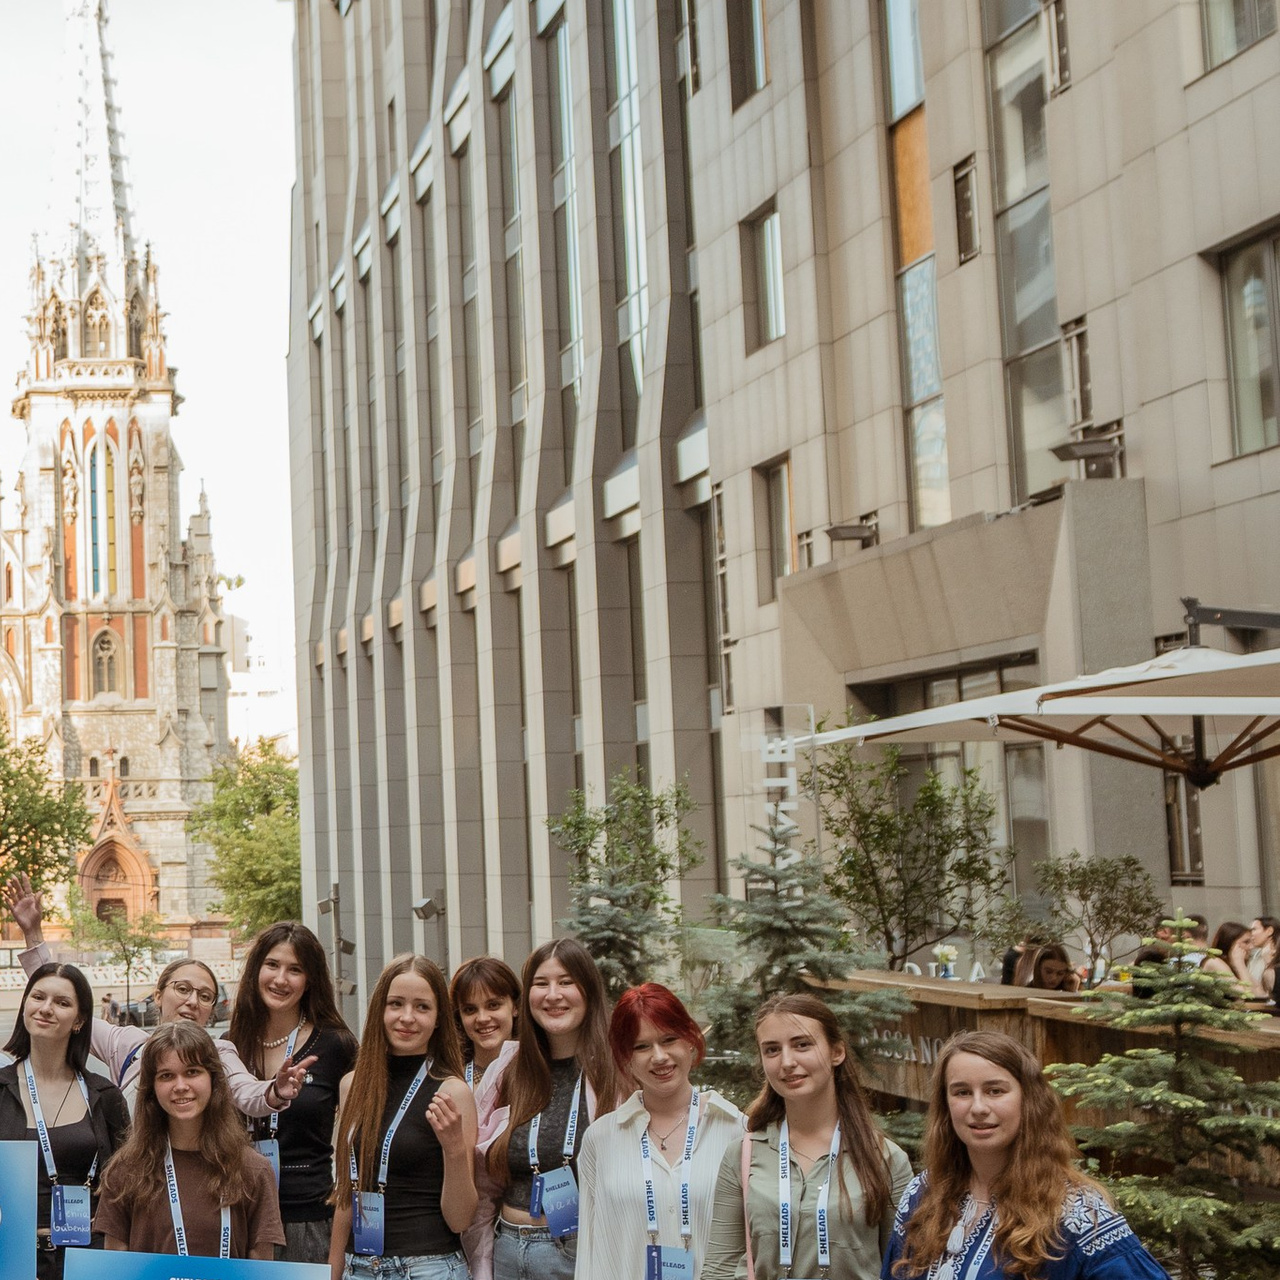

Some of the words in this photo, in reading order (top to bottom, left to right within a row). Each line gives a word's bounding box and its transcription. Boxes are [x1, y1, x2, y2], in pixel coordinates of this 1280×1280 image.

[27, 1075, 39, 1105] SHELEADS
[400, 1078, 421, 1111] SHELEADS
[37, 1120, 50, 1153] SHELEADS
[566, 1110, 577, 1146] SHELEADS
[684, 1126, 696, 1161] SHELEADS
[381, 1129, 394, 1166] SHELEADS
[166, 1164, 178, 1204] SHELEADS
[545, 1180, 570, 1192] SHELEADS
[646, 1180, 656, 1222] SHELEADS
[818, 1208, 828, 1255] SHELEADS
[662, 1262, 686, 1270] ELEADS
